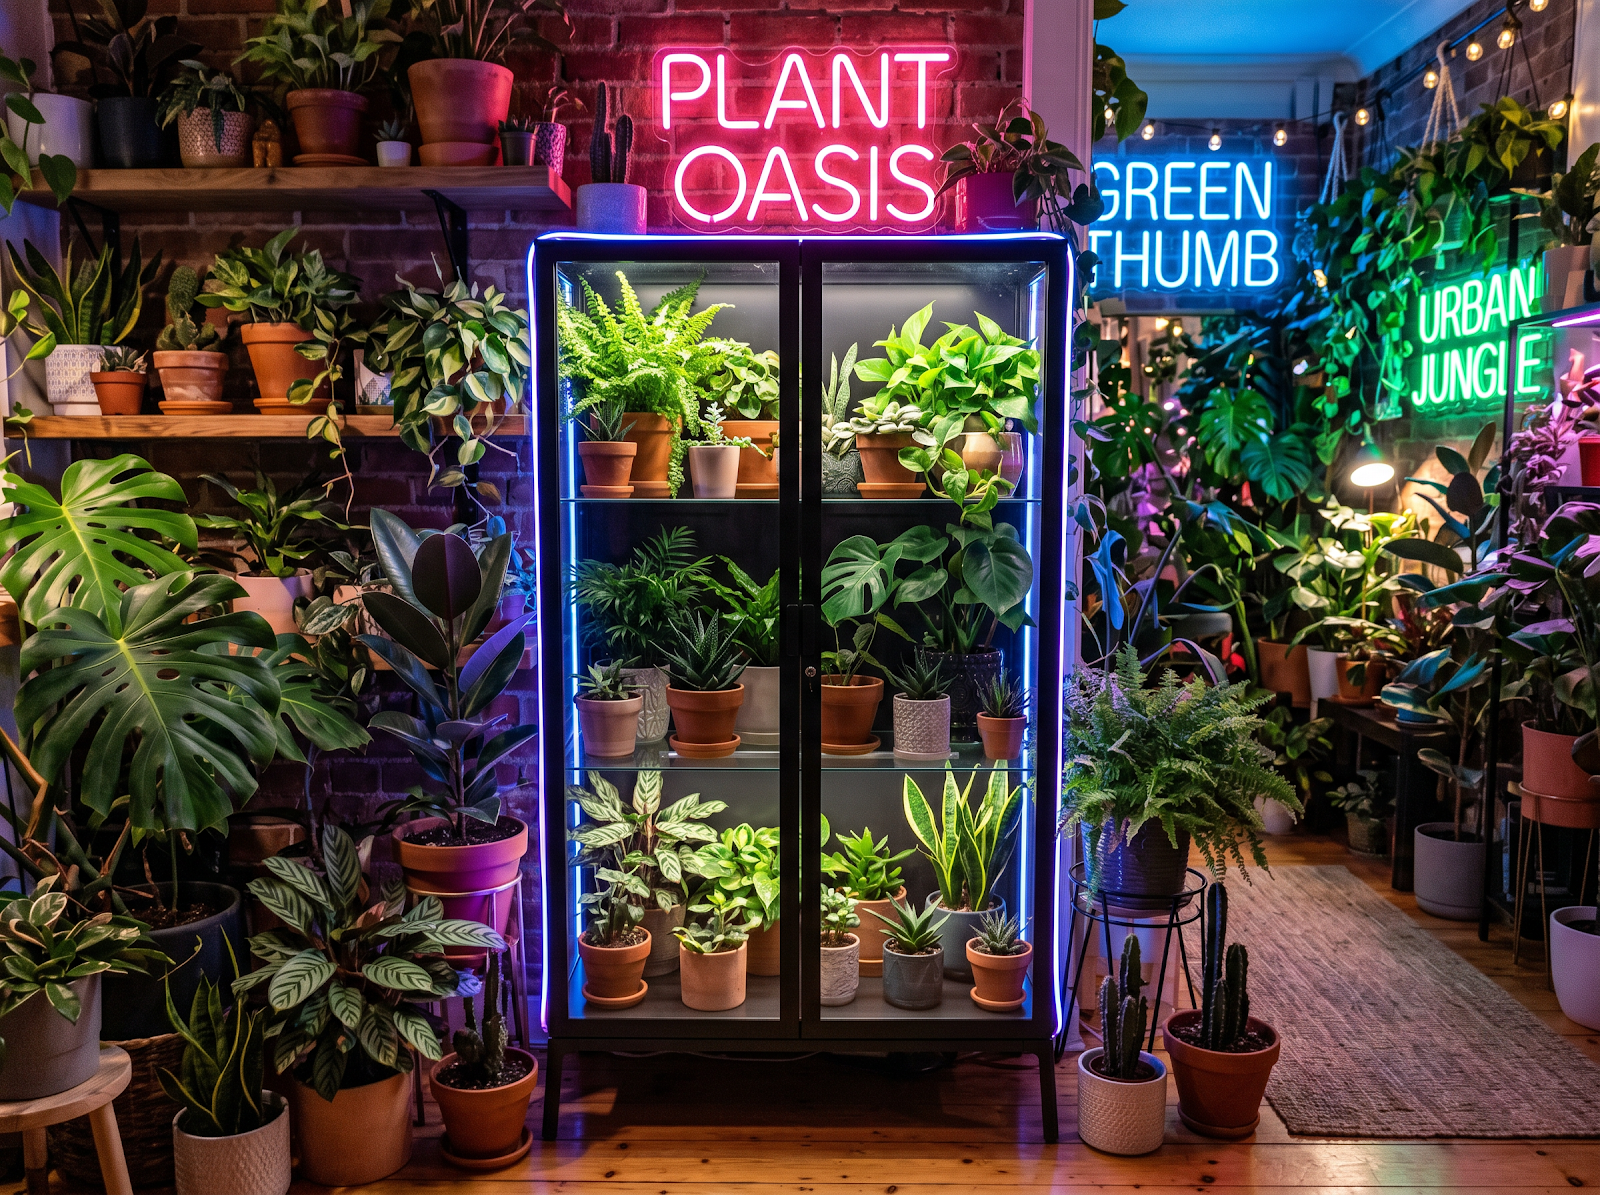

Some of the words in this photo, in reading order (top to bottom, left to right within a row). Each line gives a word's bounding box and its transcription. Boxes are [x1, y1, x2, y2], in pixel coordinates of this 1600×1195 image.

[662, 53, 950, 129] PLANT
[674, 144, 935, 222] OASIS
[1091, 161, 1272, 221] GREEN
[1088, 229, 1279, 288] THUMB
[1418, 266, 1536, 344] URBAN
[1411, 333, 1542, 406] JUNGLE
